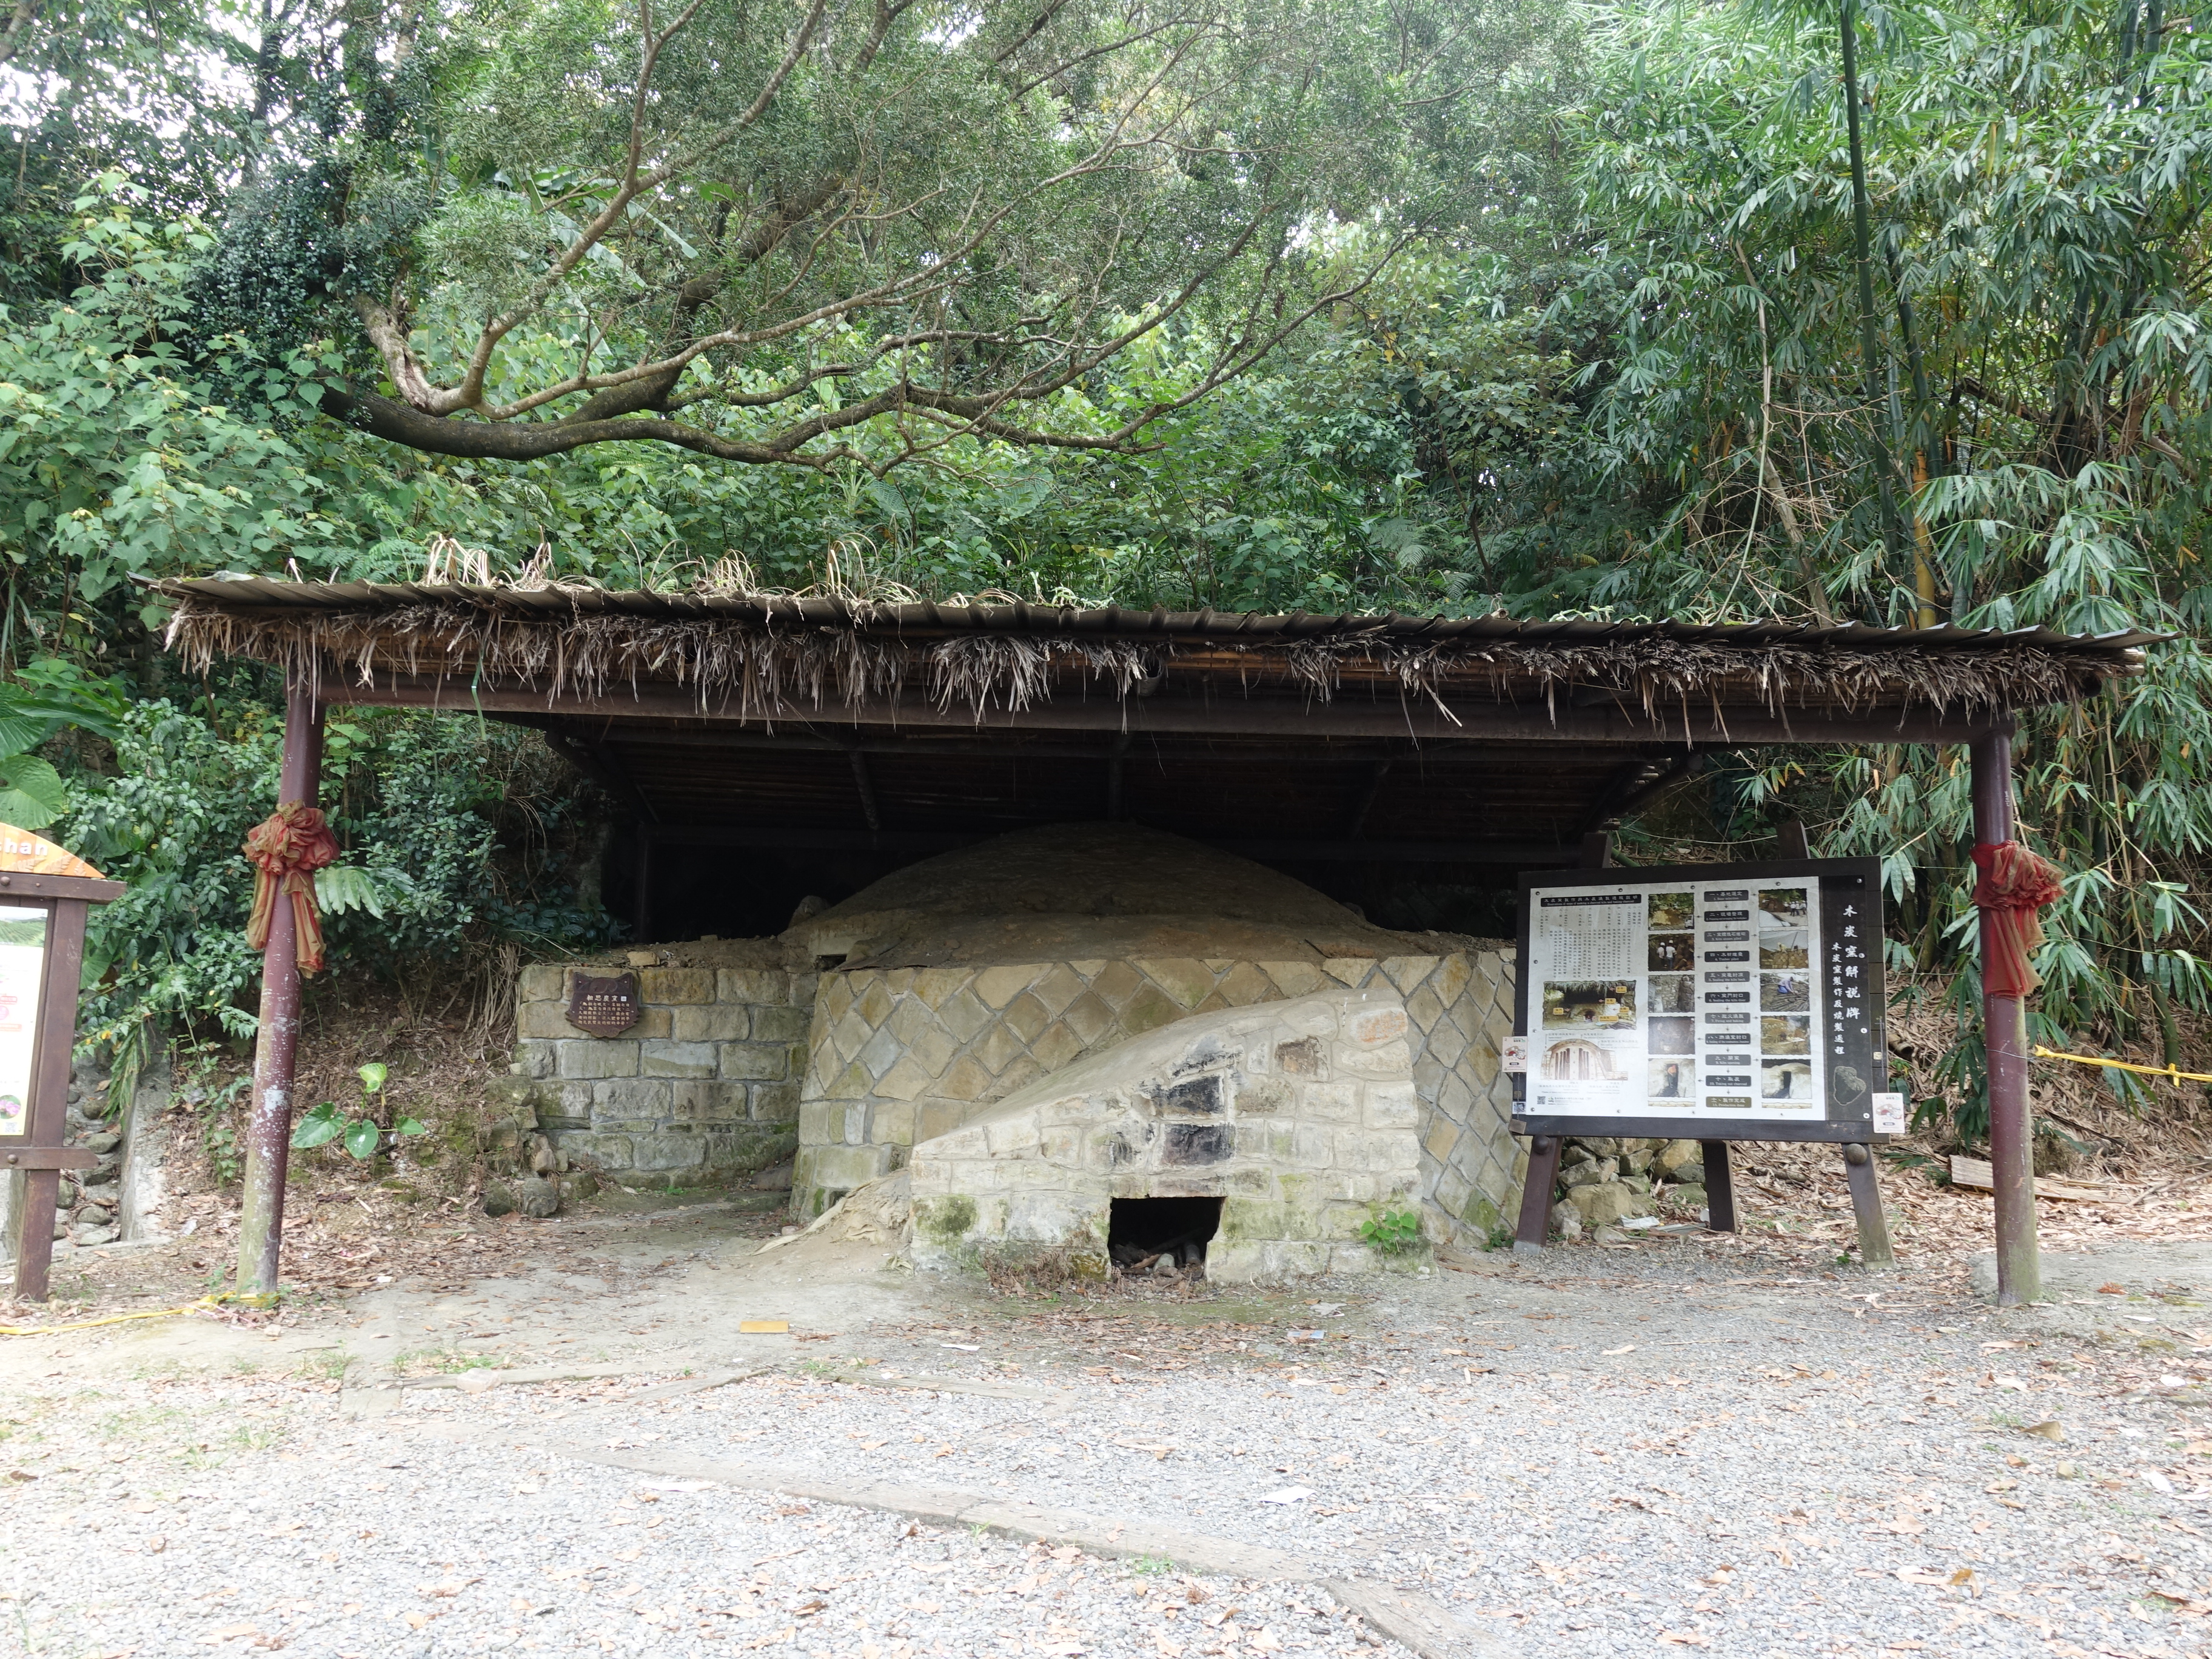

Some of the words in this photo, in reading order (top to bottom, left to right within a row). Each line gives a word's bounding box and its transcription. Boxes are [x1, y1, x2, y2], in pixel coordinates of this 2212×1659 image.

[0, 836, 48, 856] han
[1832, 942, 1845, 1054] 木炭窯製作及燒製過程
[1843, 905, 1861, 1019] 木炭窯解說牌
